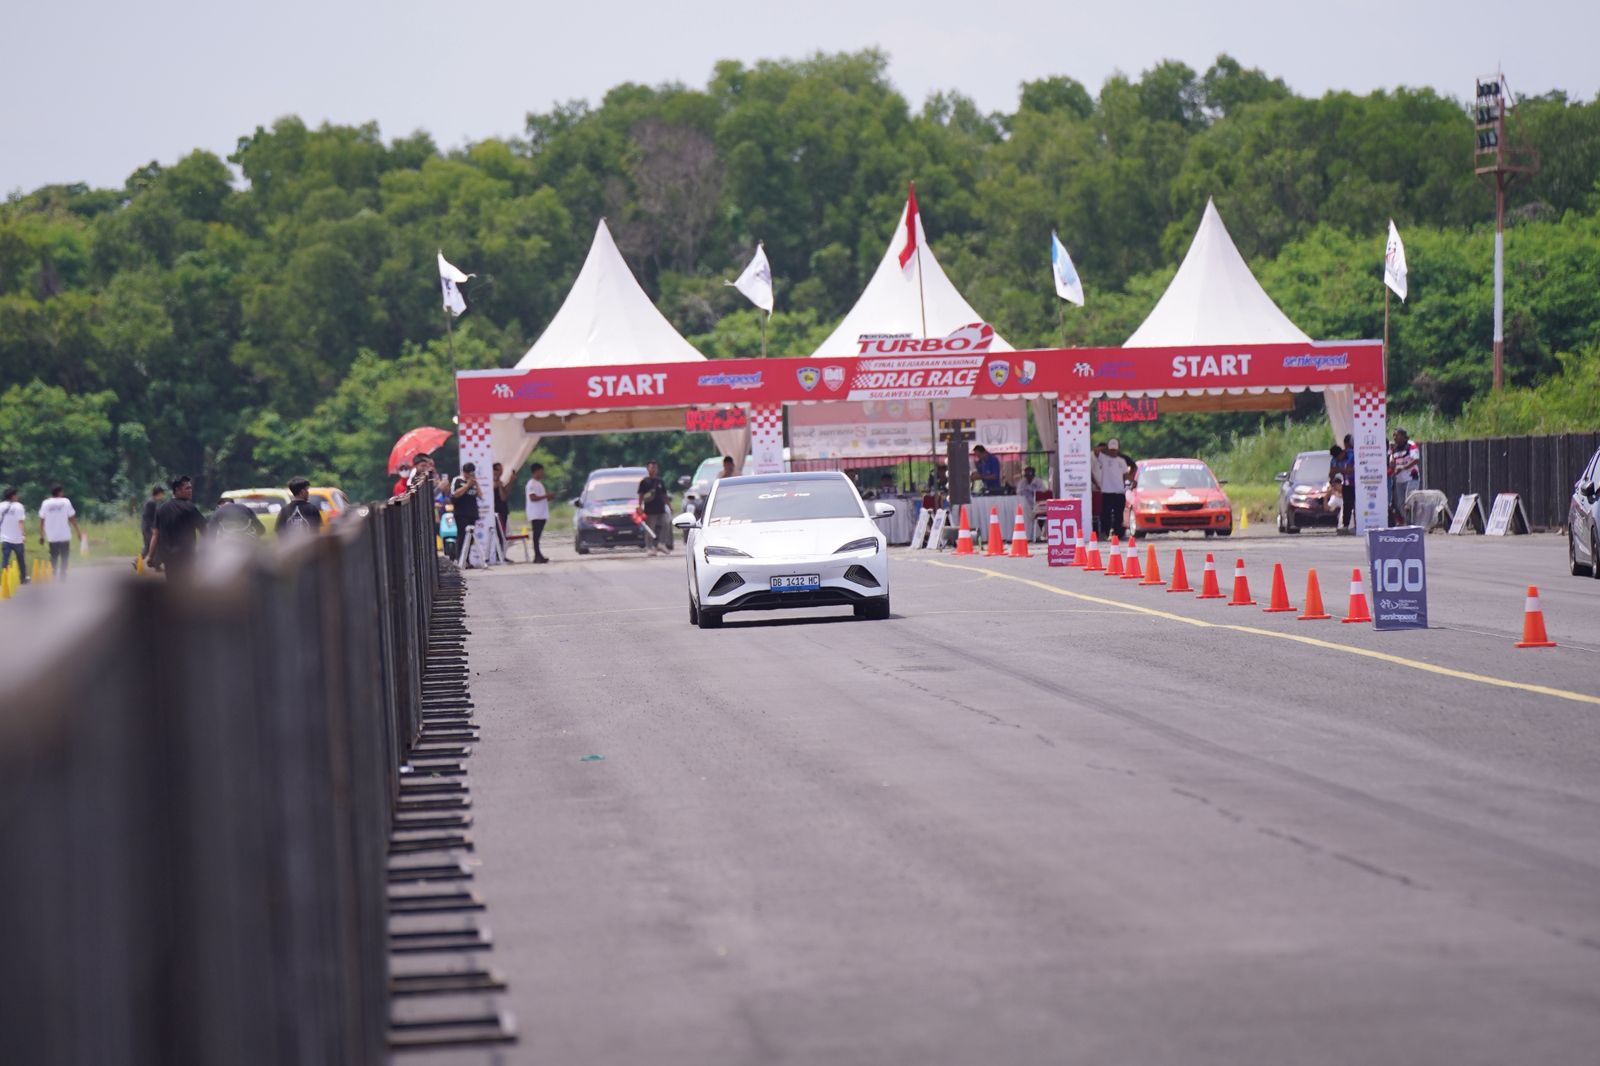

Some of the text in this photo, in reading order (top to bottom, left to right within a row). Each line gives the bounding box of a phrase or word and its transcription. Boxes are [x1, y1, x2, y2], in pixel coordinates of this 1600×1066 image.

[857, 338, 971, 353] TURBO
[874, 361, 894, 369] FINAL
[896, 360, 940, 368] KEJUARAAN
[1172, 354, 1252, 378] START
[587, 373, 667, 398] START
[870, 369, 979, 388] DRAG RACE
[869, 389, 950, 399] SULAWESI SELATAN
[1048, 518, 1077, 546] 50
[1374, 558, 1424, 592] 100
